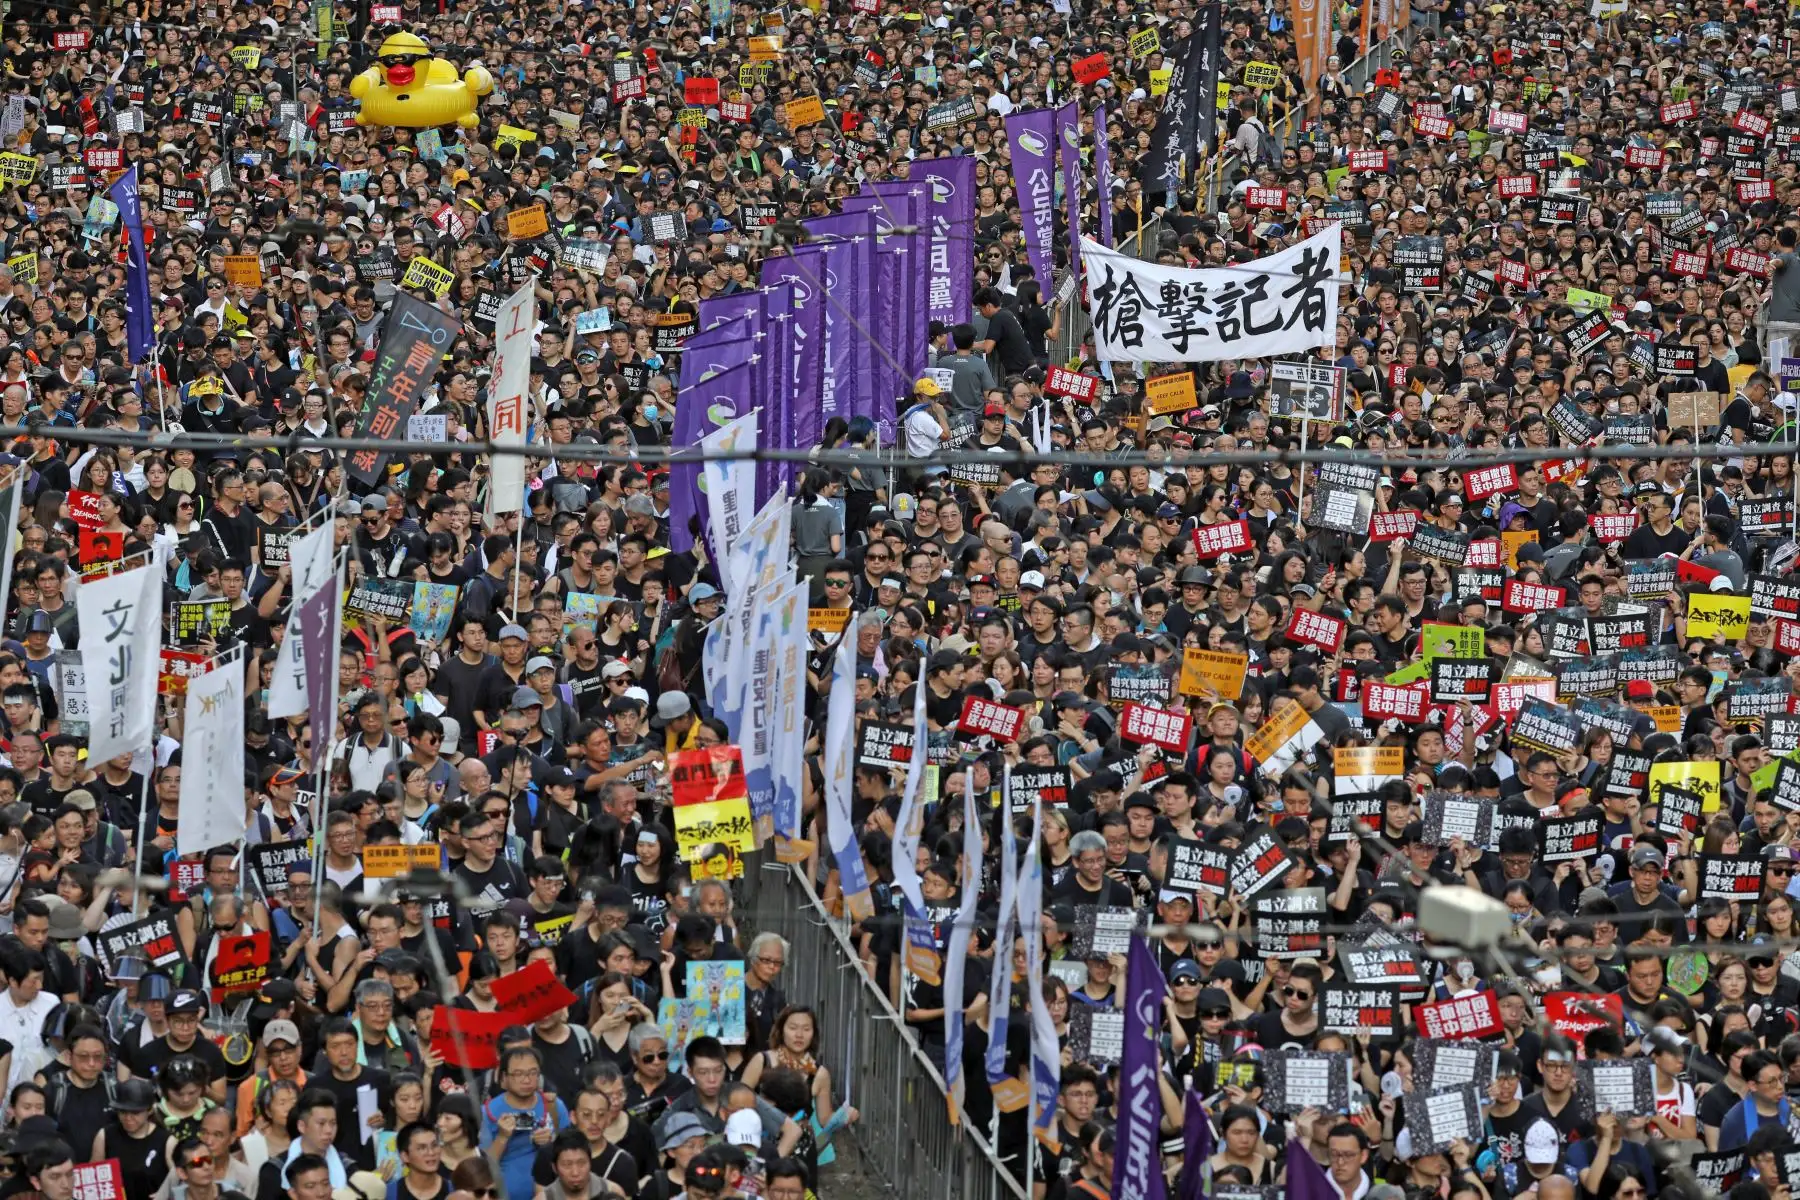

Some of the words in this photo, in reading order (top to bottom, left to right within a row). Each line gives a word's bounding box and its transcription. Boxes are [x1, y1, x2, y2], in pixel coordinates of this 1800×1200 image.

[88, 151, 119, 159] 全面撤回
[53, 166, 85, 175] 獨立調查
[88, 159, 118, 167] 送中惡法
[162, 188, 194, 199] 獨立調查
[1251, 188, 1282, 197] 全面撤回
[1251, 196, 1282, 206] 送中惡法
[1542, 201, 1574, 211] 獨立調查
[745, 207, 776, 218] 獨立調查
[1676, 254, 1706, 266] 全面撤回
[1732, 250, 1766, 265] 全面撤回
[407, 271, 423, 284] FOR
[411, 261, 440, 280] STAND
[440, 272, 452, 283] UP
[1406, 268, 1439, 277] 獨立調查
[1093, 248, 1333, 354] 槍擊記者
[658, 327, 695, 338] 獨立調查
[1567, 314, 1602, 341] 獨立調查
[1658, 348, 1694, 359] 獨立調查
[1657, 358, 1695, 369] 警察鎮壓
[1053, 367, 1091, 389] 全面撤回
[1050, 377, 1089, 398] 送中惡法
[491, 394, 522, 439] 同
[1607, 426, 1650, 435] 追究警察暴行
[951, 470, 999, 484] 反對定性暴動
[1322, 462, 1377, 479] 追究警察暴行
[1470, 465, 1511, 484] 全面撤回
[1320, 470, 1374, 489] 反對定性暴動
[1472, 476, 1513, 495] 送中惡法
[1742, 502, 1781, 514] 獨立調查
[1373, 513, 1416, 524] 全面撤回
[1594, 517, 1634, 527] 全面撤回
[1741, 513, 1781, 525] 警察鎮壓
[1198, 523, 1242, 540] 全面撤回
[1200, 534, 1245, 552] 送中惡法
[1415, 533, 1466, 552] 追究警察暴行
[1413, 541, 1463, 561] 反對定性暴動
[1458, 574, 1501, 586] 獨立調查
[1628, 572, 1675, 583] 追究警察暴行
[1511, 583, 1559, 601] 全面撤回
[1753, 580, 1800, 597] 獨立調查
[1752, 595, 1799, 610] 警察鎮壓
[1299, 612, 1339, 634] 全面撤回
[1594, 620, 1646, 635] 獨立調查
[1294, 624, 1336, 646] 送中惡法
[1596, 634, 1647, 649] 警察鎮壓
[1439, 664, 1489, 678] 獨立調查
[1619, 660, 1676, 670] 追究警察暴行
[1110, 678, 1169, 688] 追究警察暴行
[1561, 669, 1618, 682] 追究警察暴行
[1618, 671, 1676, 681] 反對定性暴動
[1438, 679, 1487, 693] 警察鎮壓
[1498, 684, 1549, 697] 全面撤回
[1560, 680, 1616, 692] 反對定性暴動
[1370, 686, 1422, 702] 全面撤回
[1730, 692, 1789, 704] 追究警察暴行
[971, 701, 1019, 724] 全面撤回
[1368, 699, 1421, 716] 送中惡法
[966, 714, 1014, 737] 送中惡法
[1130, 706, 1184, 731] 全面撤回
[1127, 719, 1180, 744] 送中惡法
[1521, 713, 1577, 741] 追究警察暴行
[1010, 774, 1064, 788] 獨立調查
[1012, 787, 1067, 804] 警察鎮壓
[1333, 800, 1381, 815] 獨立調查
[1546, 820, 1598, 838] 獨立調查
[1545, 836, 1598, 853] 警察鎮壓
[1175, 846, 1227, 868] 獨立調查
[1174, 863, 1226, 885] 警察鎮壓
[1706, 860, 1762, 875] 獨立調查
[1705, 876, 1760, 891] 警察鎮壓
[1258, 896, 1318, 912] 獨立調查
[1258, 919, 1320, 933] 獨立調查
[108, 921, 170, 954] 獨立調查
[1348, 950, 1413, 965] 獨立調查
[1326, 990, 1392, 1008] 獨立調查
[1423, 996, 1489, 1022] 全面撤回
[1326, 1009, 1391, 1025] 警察鎮壓
[1427, 1012, 1494, 1039] 送中惡法
